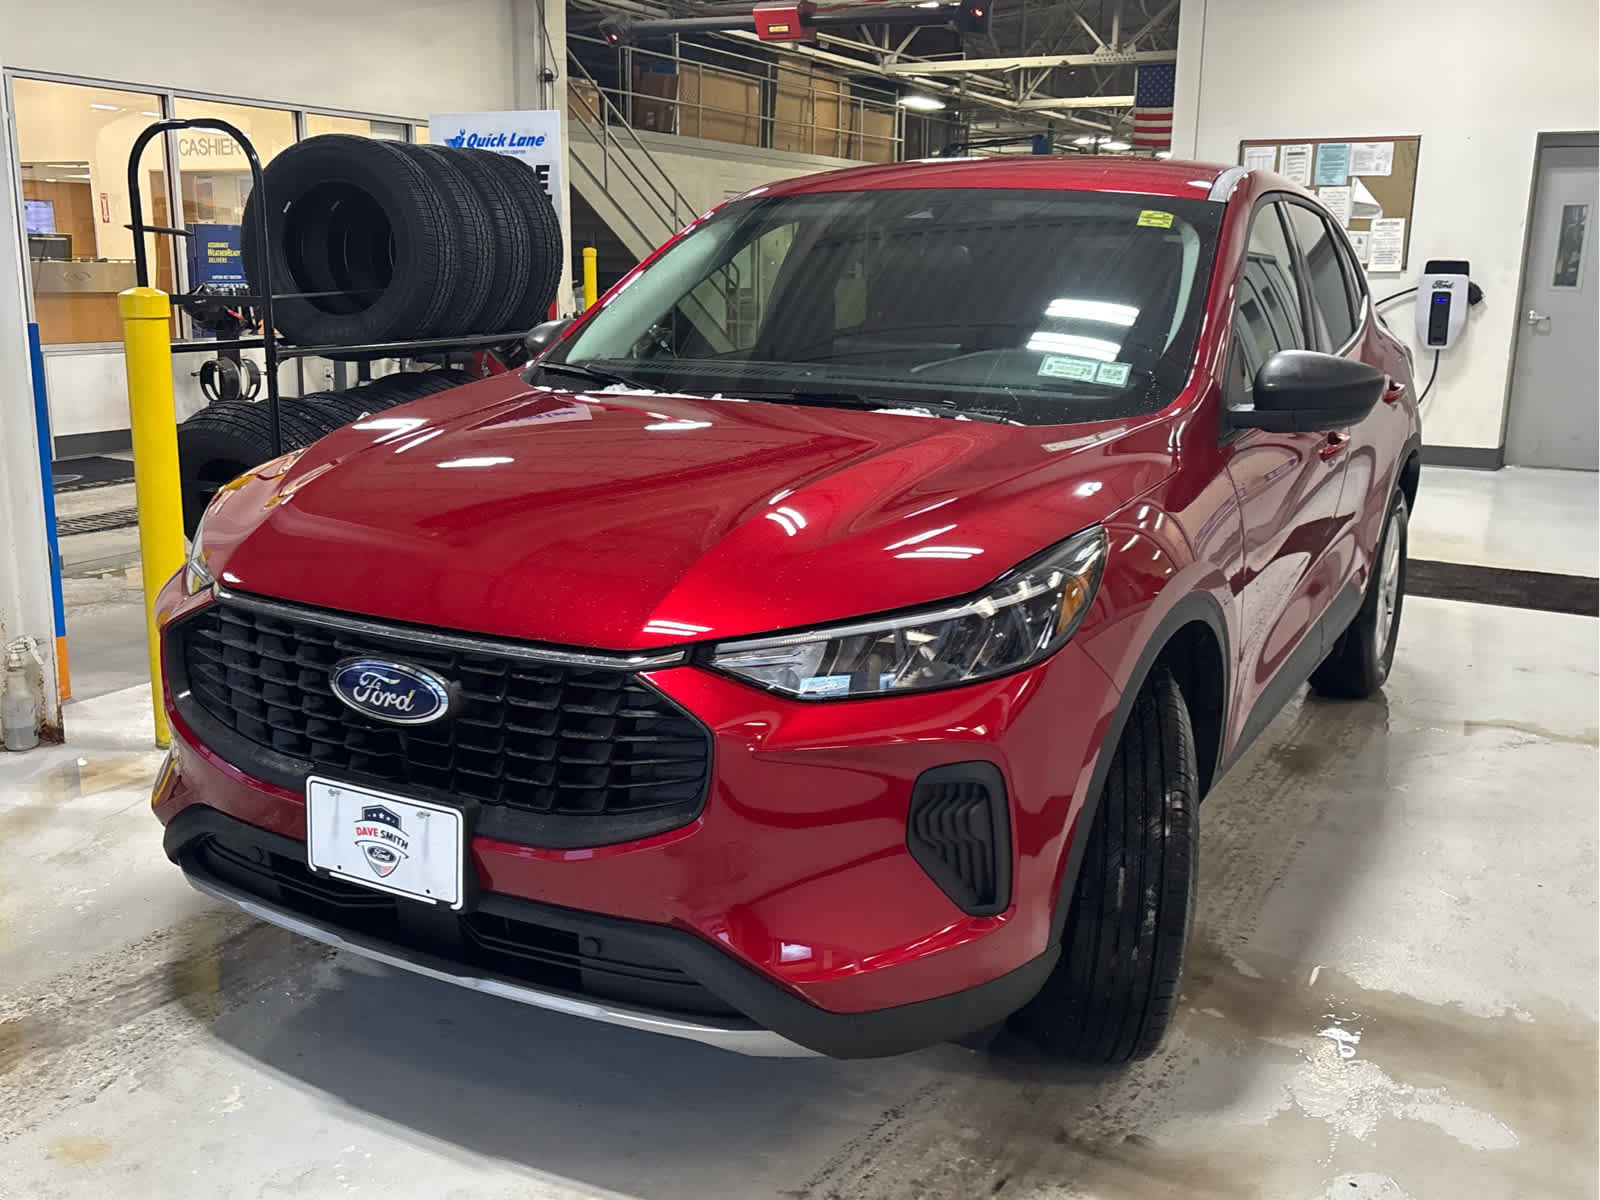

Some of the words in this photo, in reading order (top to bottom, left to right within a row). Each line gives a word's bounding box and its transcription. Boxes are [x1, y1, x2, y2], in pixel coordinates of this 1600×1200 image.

[467, 132, 507, 148] Quick
[508, 132, 545, 147] Lane
[1432, 280, 1454, 289] Ford
[353, 671, 416, 712] Ford
[356, 827, 378, 837] DAVE
[380, 830, 408, 850] SMITH
